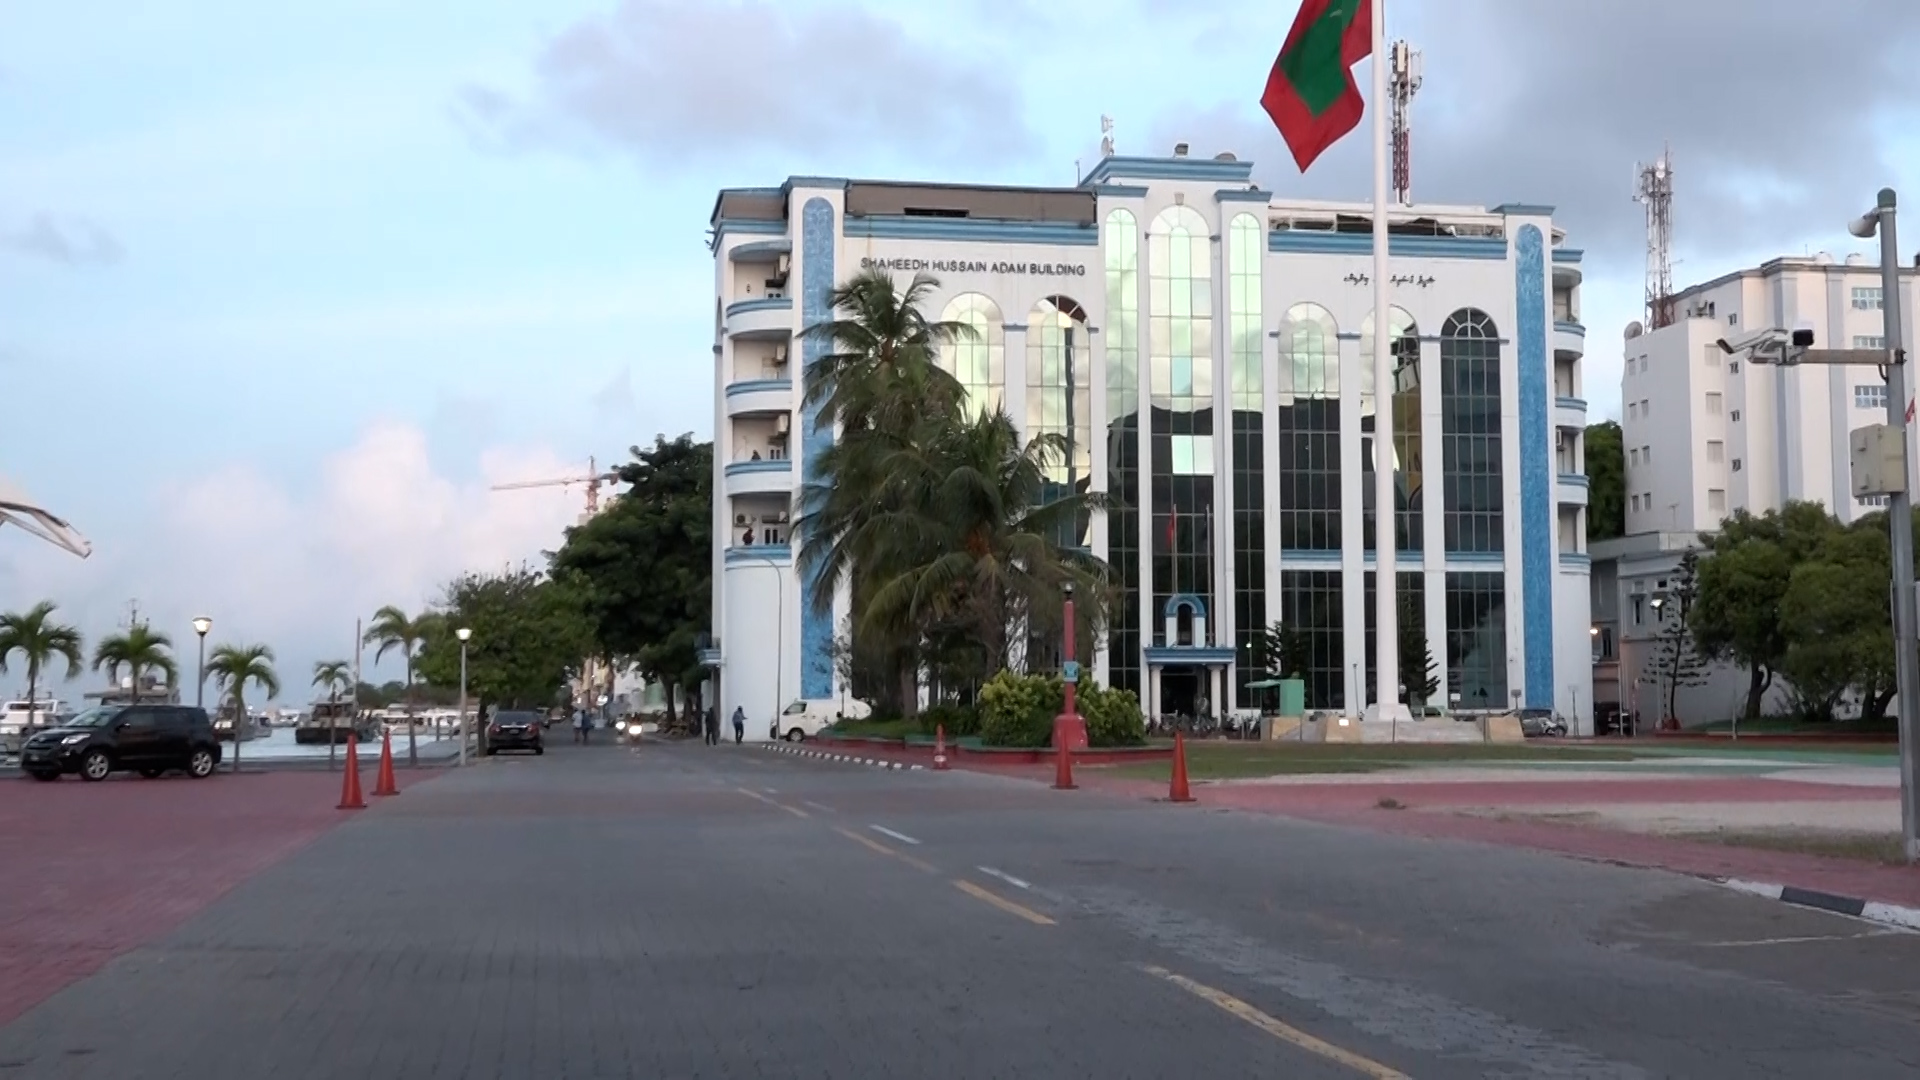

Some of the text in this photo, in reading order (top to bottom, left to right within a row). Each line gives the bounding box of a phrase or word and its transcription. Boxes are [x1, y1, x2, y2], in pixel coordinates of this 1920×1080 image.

[860, 257, 1086, 276] SHAHEEDH HUSSAIN ADAM BUILDING
